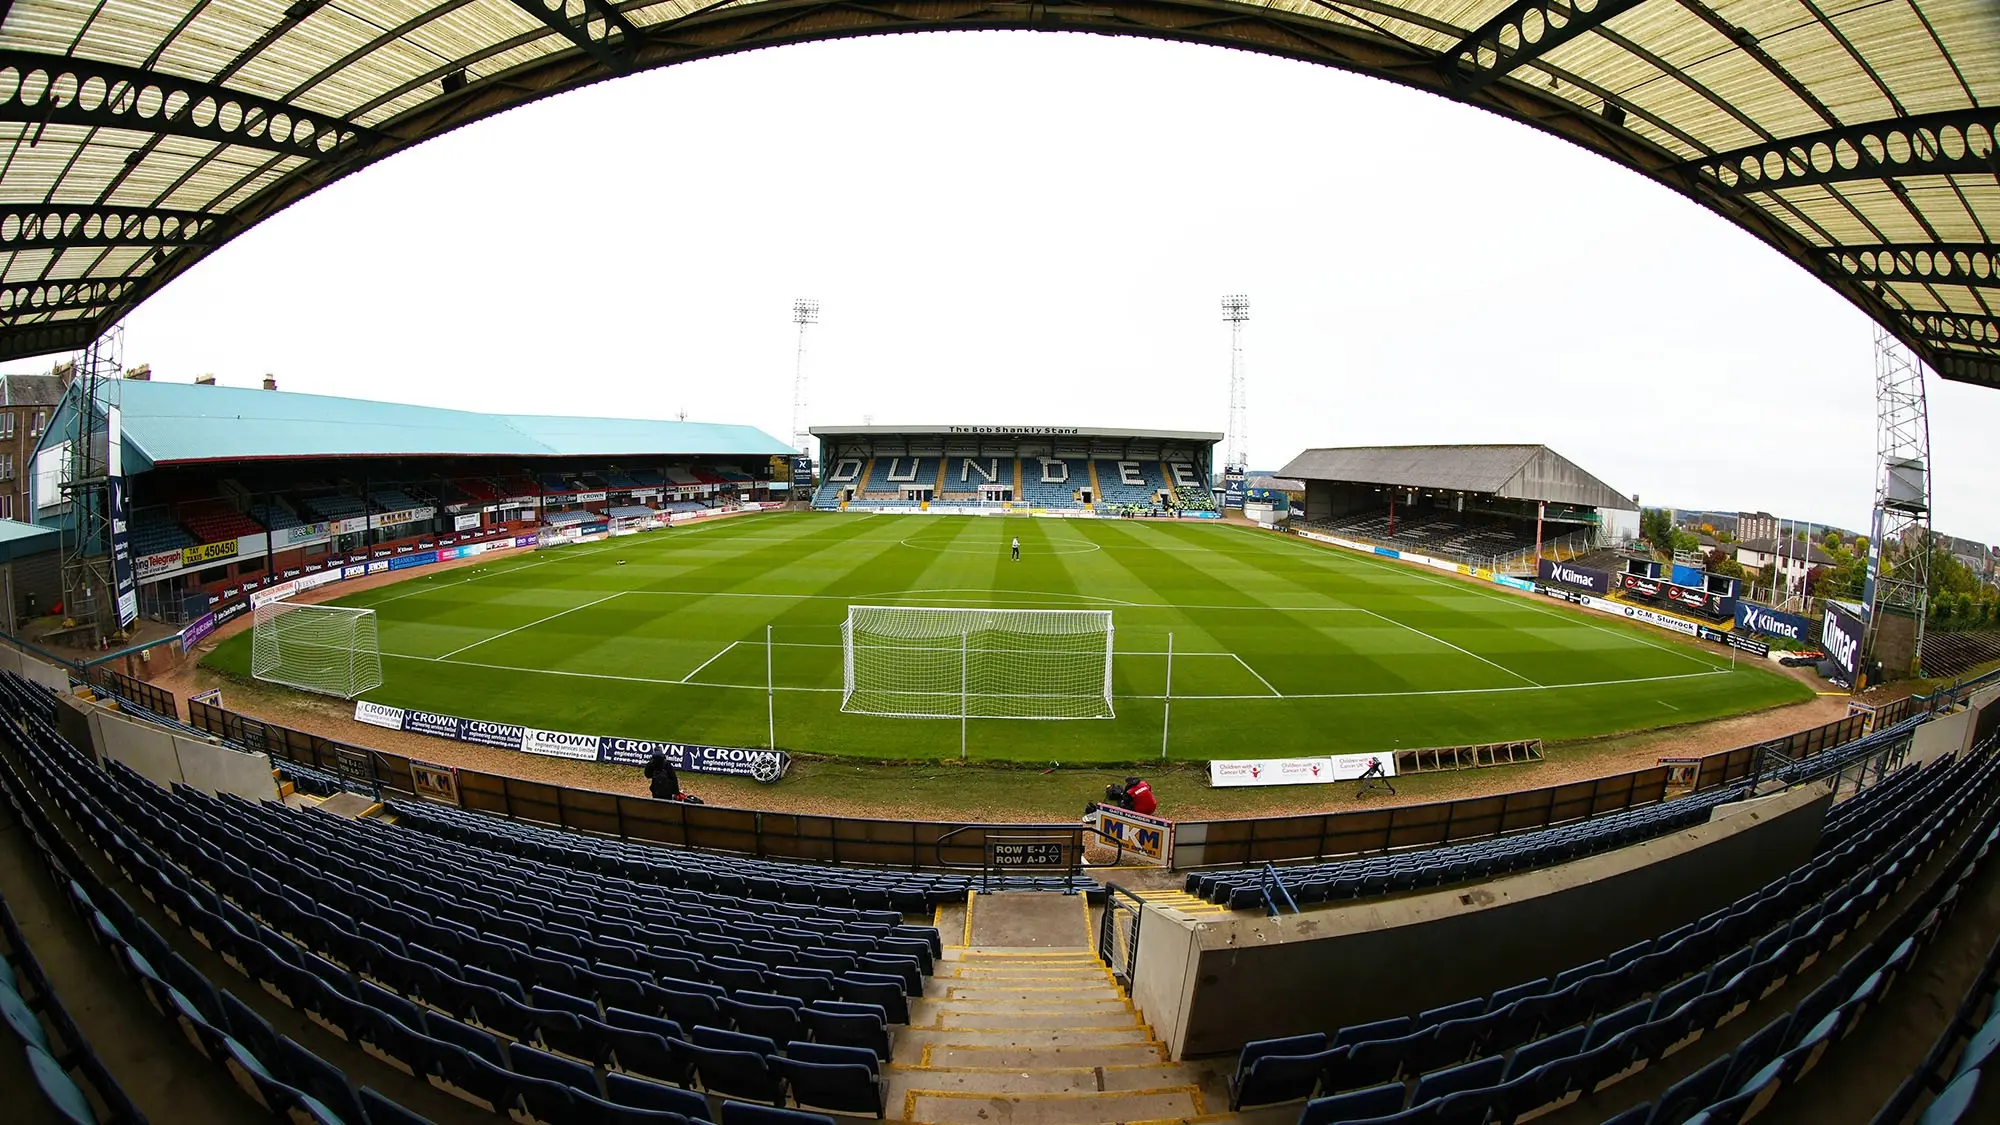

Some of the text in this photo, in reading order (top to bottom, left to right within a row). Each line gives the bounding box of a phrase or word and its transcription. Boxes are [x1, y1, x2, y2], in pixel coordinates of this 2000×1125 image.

[995, 426, 1041, 435] Shankly
[148, 550, 181, 567] Telegraph
[186, 542, 236, 563] TAXIS 450450
[189, 546, 200, 556] TAY
[344, 565, 365, 577] JEWSON
[368, 560, 389, 573] JEWSON
[1562, 568, 1594, 587] Kilmac
[1637, 610, 1655, 620] C.M.
[1656, 615, 1694, 631] Sturrock
[1758, 613, 1799, 639] Kilmac
[1821, 609, 1858, 673] Kilmac
[364, 703, 403, 719] CROWN
[412, 711, 458, 728] CROWN
[469, 721, 523, 738] CROWN
[534, 742, 596, 754] engineering services limited
[535, 731, 597, 748] CROWN
[615, 739, 685, 757] CROWN
[533, 747, 595, 759] crown-engineering.co.uk
[614, 750, 643, 760] engineering
[703, 748, 781, 765] CROWN
[702, 759, 735, 770] engineering
[1219, 763, 1240, 771] Children
[415, 769, 452, 793] MKM
[1104, 818, 1160, 852] MKM
[996, 845, 1046, 854] ROW E-J
[996, 855, 1047, 864] ROW A-D
